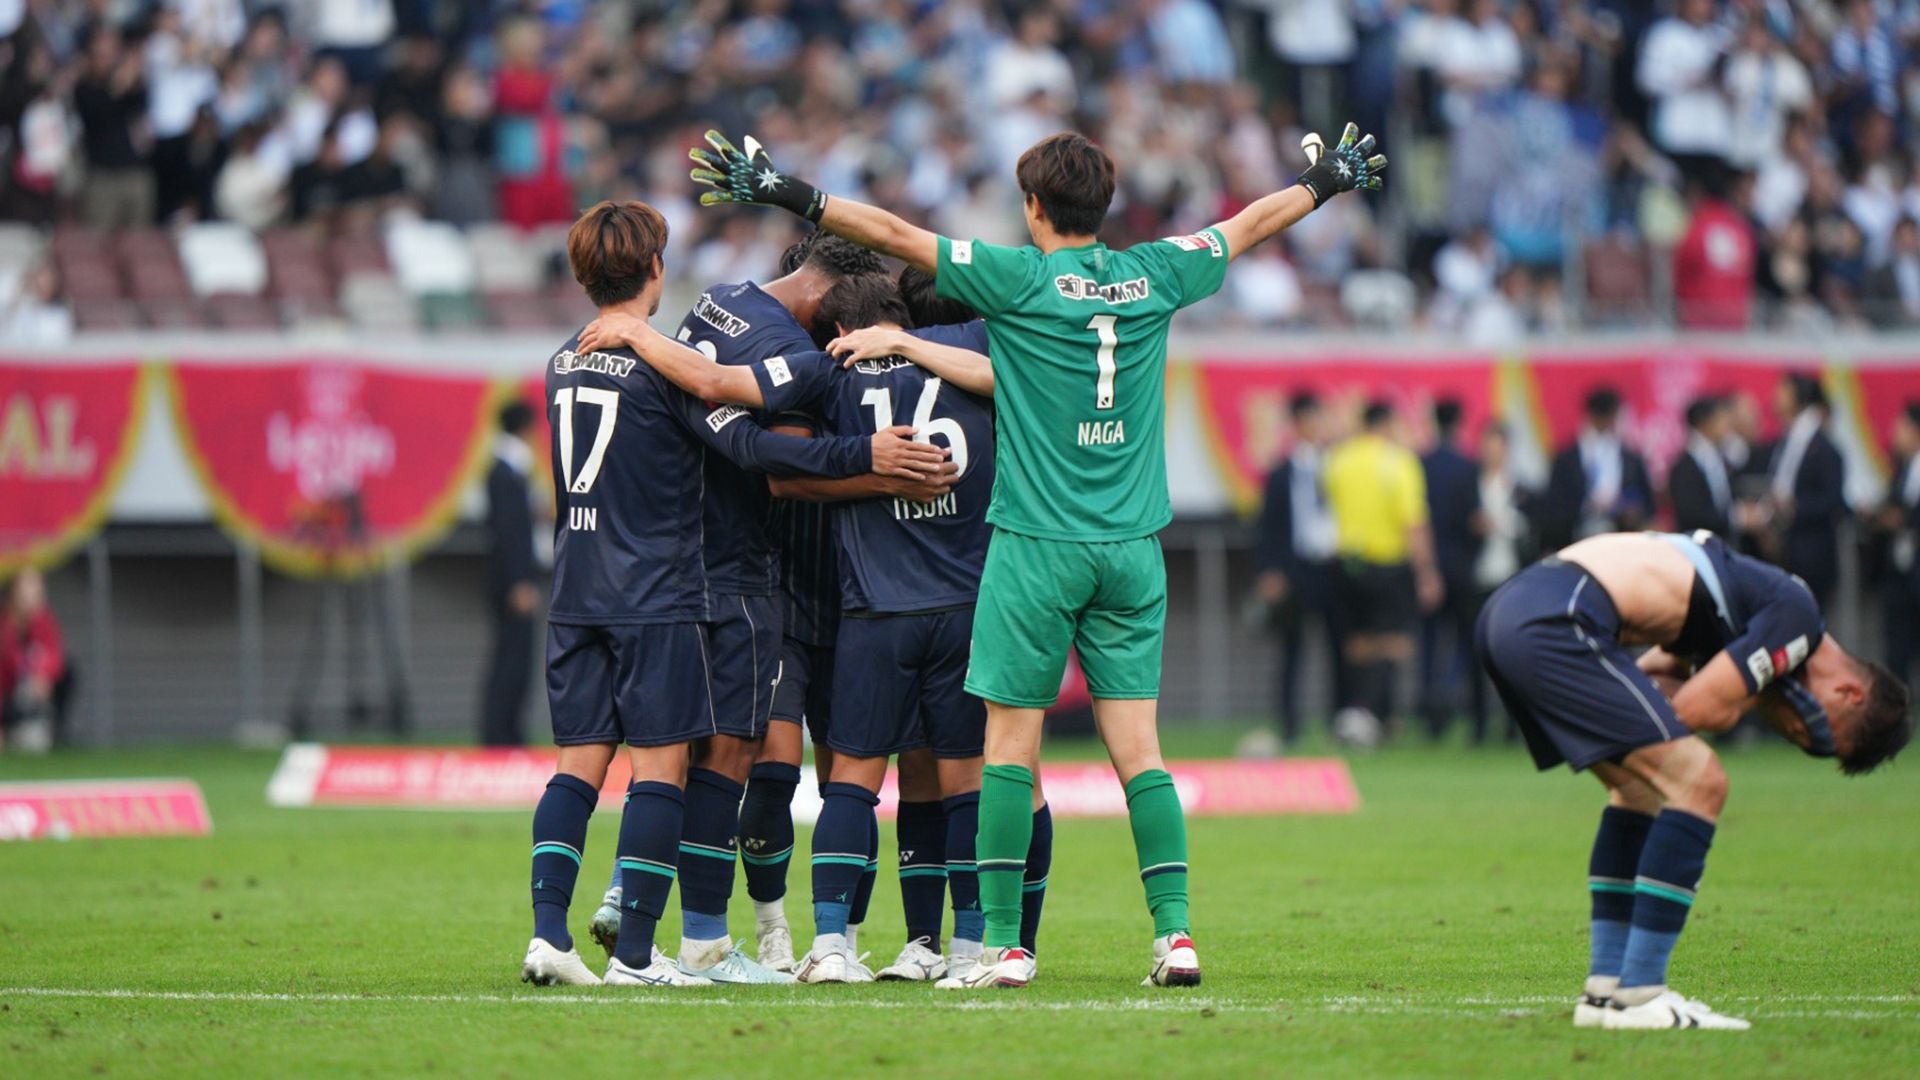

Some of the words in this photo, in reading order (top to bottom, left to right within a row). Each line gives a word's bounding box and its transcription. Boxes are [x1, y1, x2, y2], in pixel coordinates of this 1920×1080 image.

[1124, 277, 1148, 300] TV
[701, 301, 729, 332] DMM
[725, 317, 751, 337] TV
[608, 355, 636, 378] TV
[1086, 314, 1118, 409] 1
[554, 386, 620, 493] 17
[1077, 420, 1125, 446] NAGA
[570, 507, 597, 530] UN
